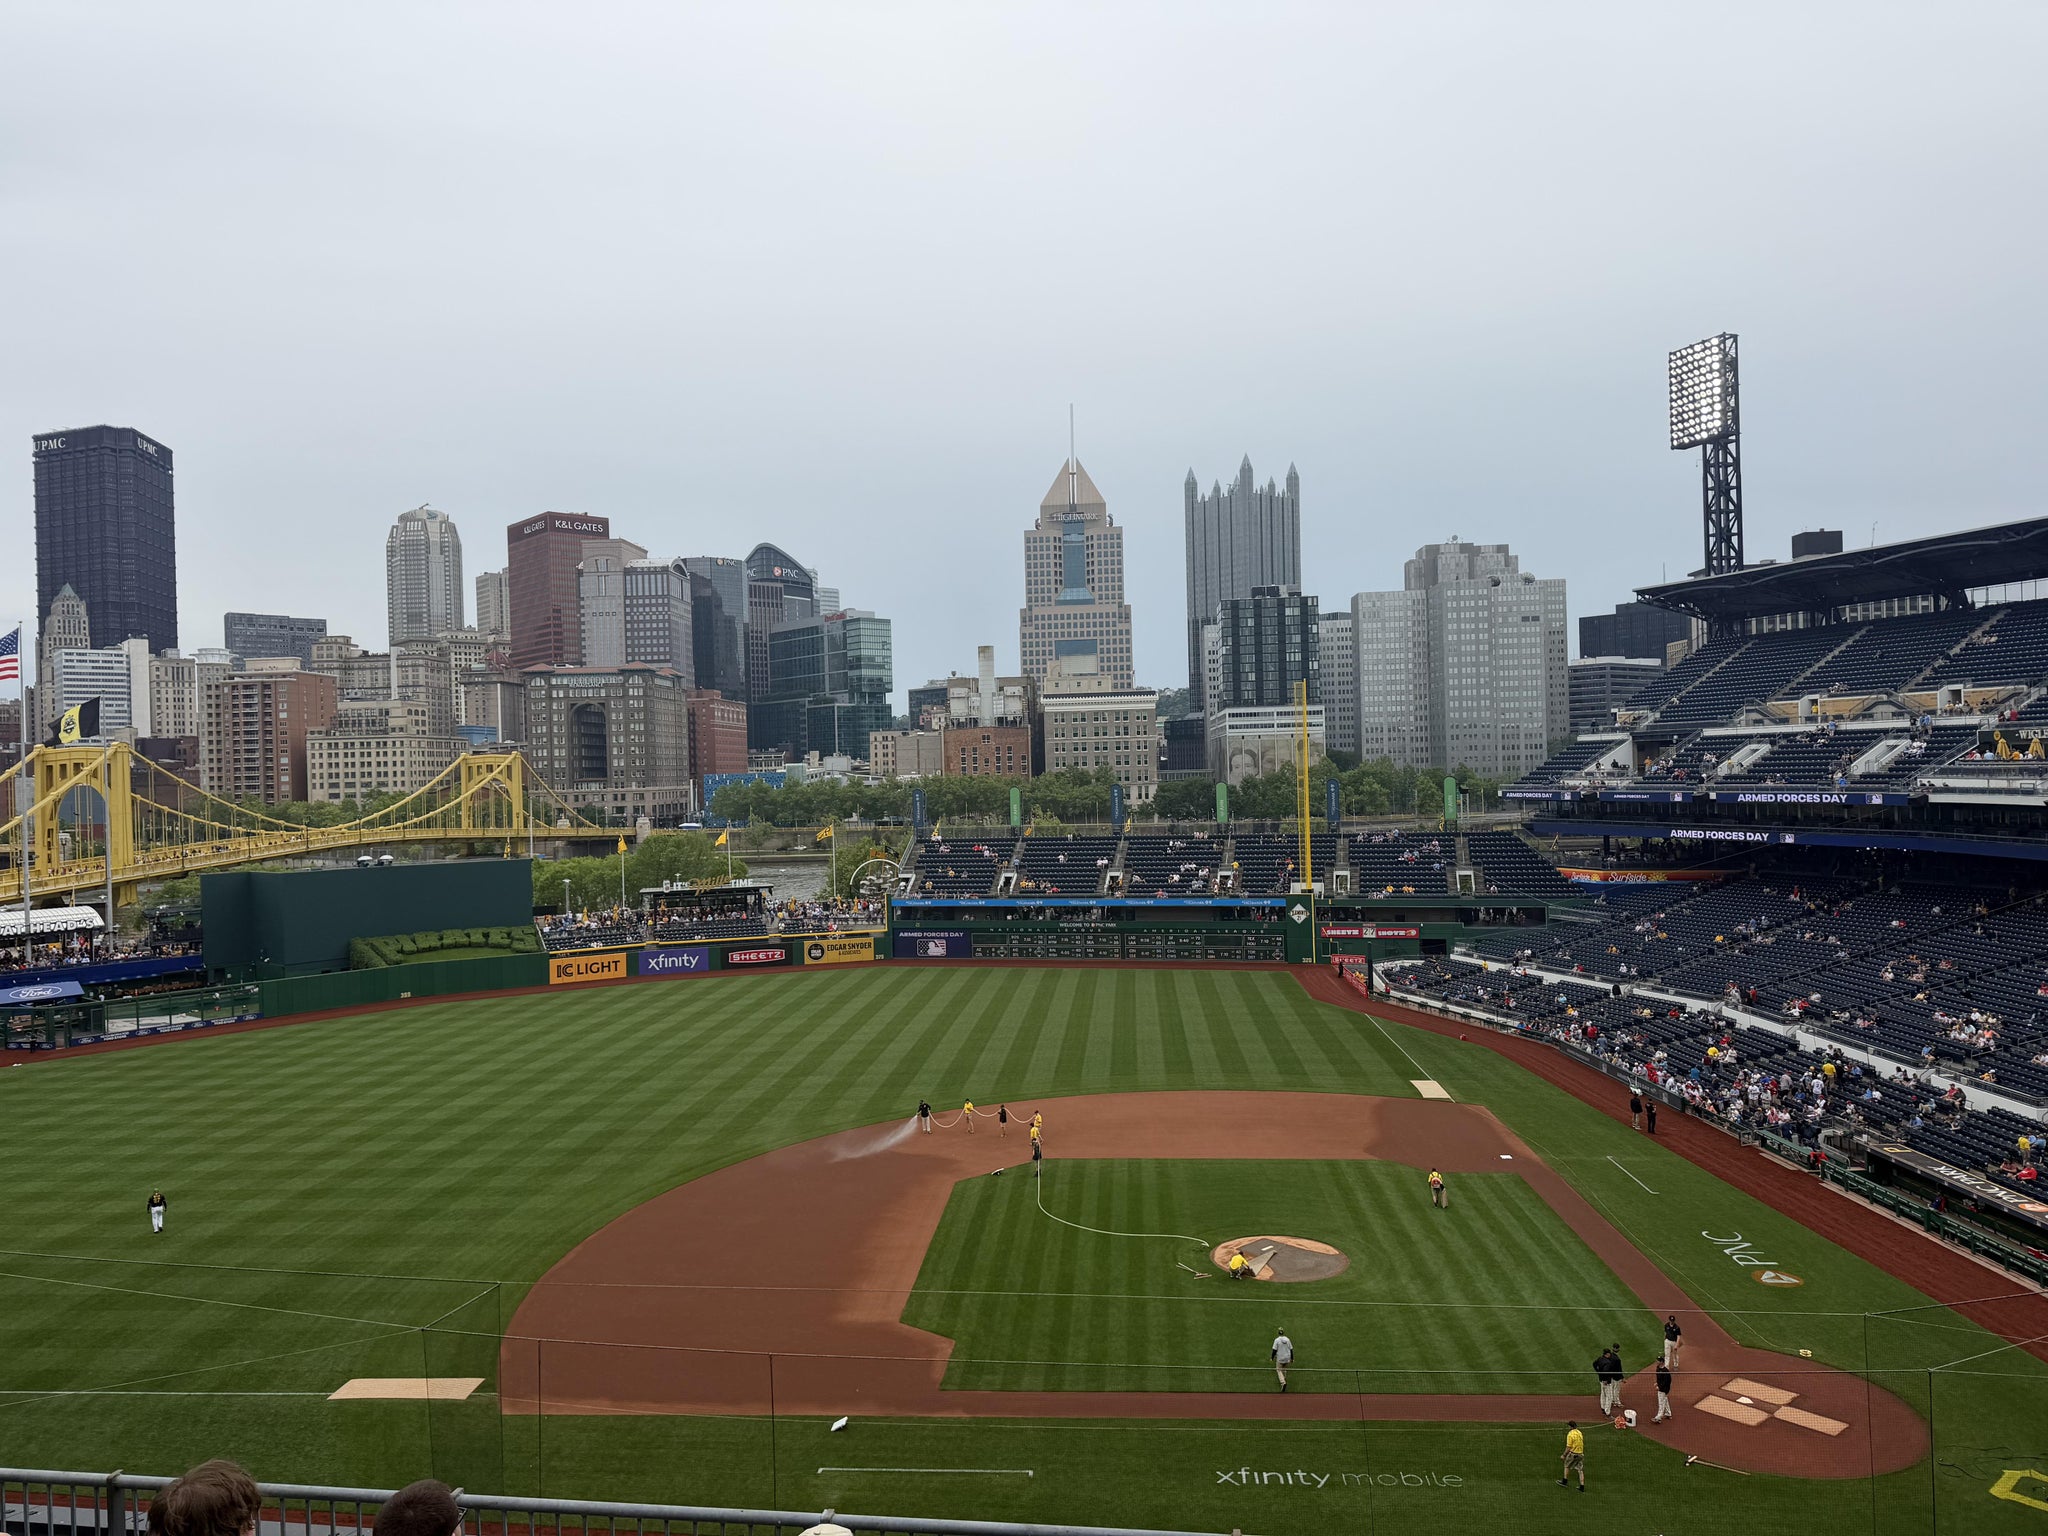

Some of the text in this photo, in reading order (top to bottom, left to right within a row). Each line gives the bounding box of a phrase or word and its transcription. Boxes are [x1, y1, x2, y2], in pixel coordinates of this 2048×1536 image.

[33, 438, 66, 452] UPMC
[138, 438, 158, 456] UPMC
[555, 520, 603, 532] K&L GATES
[783, 568, 799, 578] PNC
[1738, 794, 1847, 803] ARMED FORCES DAY
[1670, 829, 1769, 842] ARMED FORCES DAY
[731, 879, 753, 887] TIME
[1608, 871, 1647, 883] Surfside
[733, 951, 781, 960] SHEETZ
[648, 954, 699, 970] xfinity
[557, 960, 620, 978] IC LIGHT
[20, 987, 53, 998] Ford
[1702, 1231, 1779, 1266] PNC
[1216, 1467, 1463, 1488] xfinity mobile
